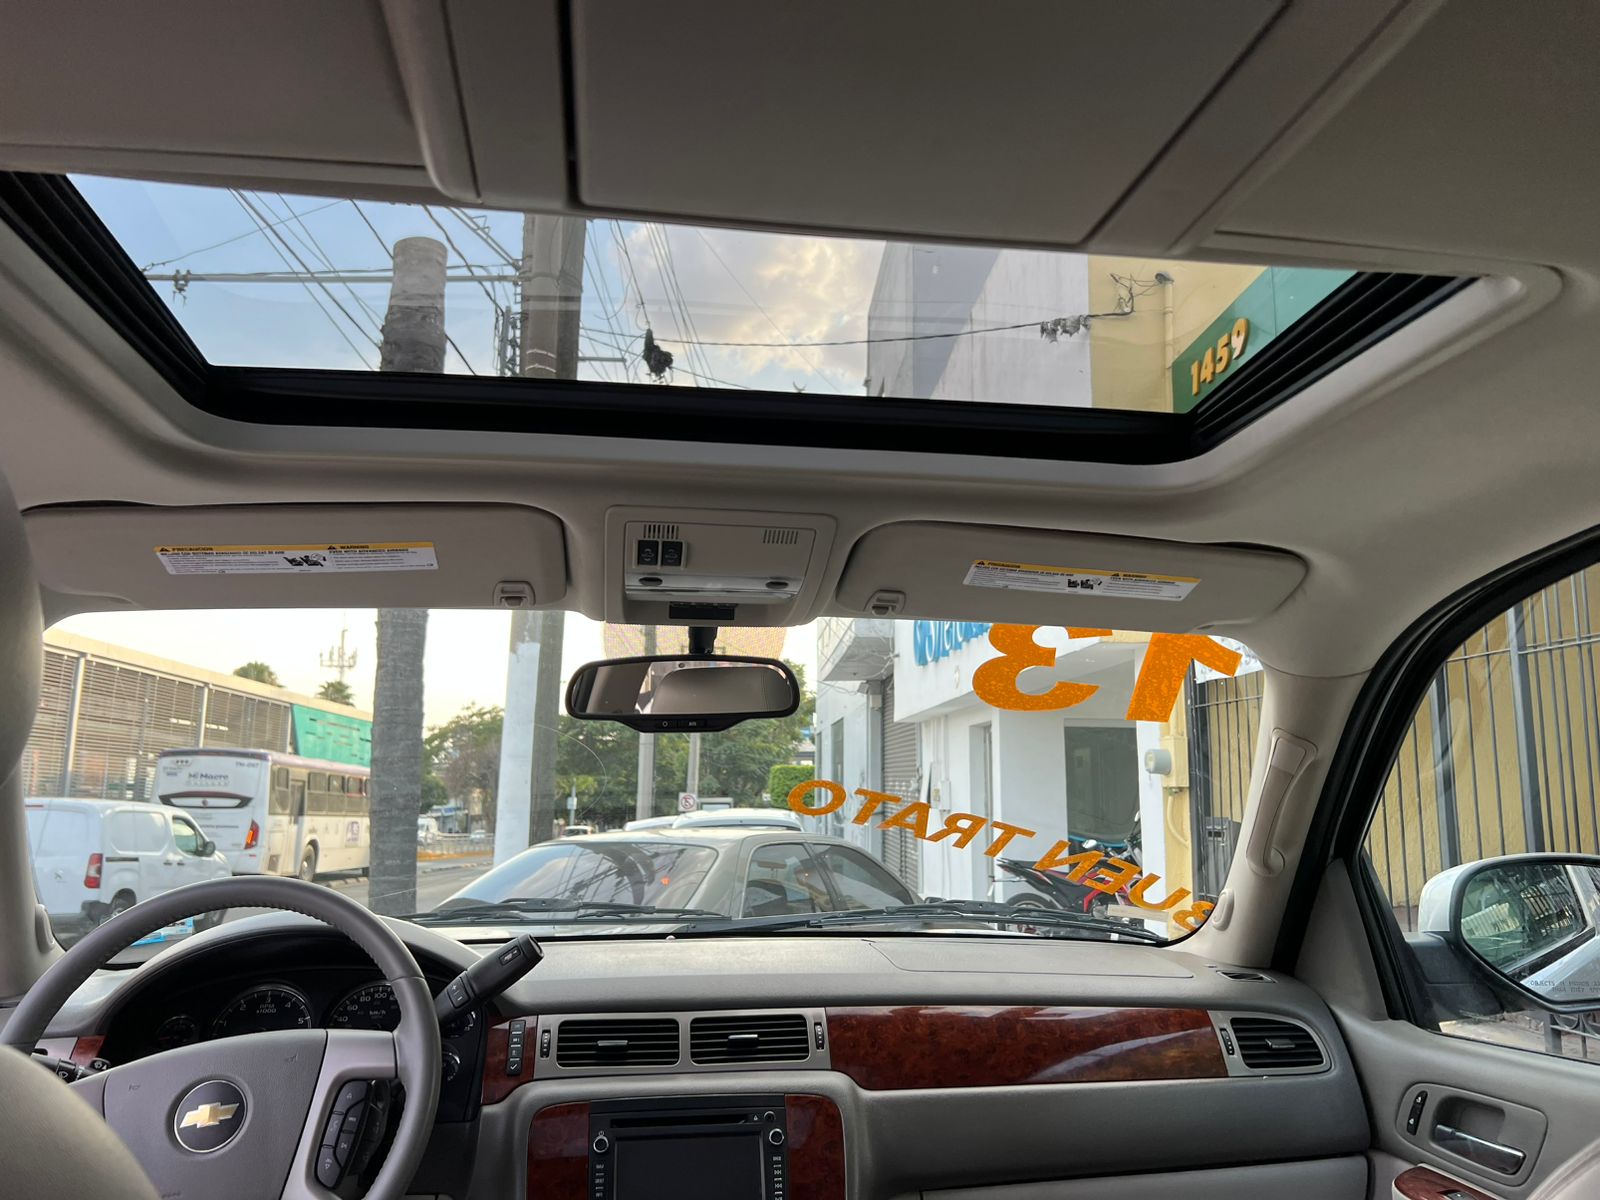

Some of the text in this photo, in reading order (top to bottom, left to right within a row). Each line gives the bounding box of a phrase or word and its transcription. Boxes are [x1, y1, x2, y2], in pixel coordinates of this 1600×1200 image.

[1191, 318, 1250, 397] 1459
[200, 772, 229, 781] Macro
[360, 995, 371, 1003] 80
[297, 1017, 304, 1025] 5
